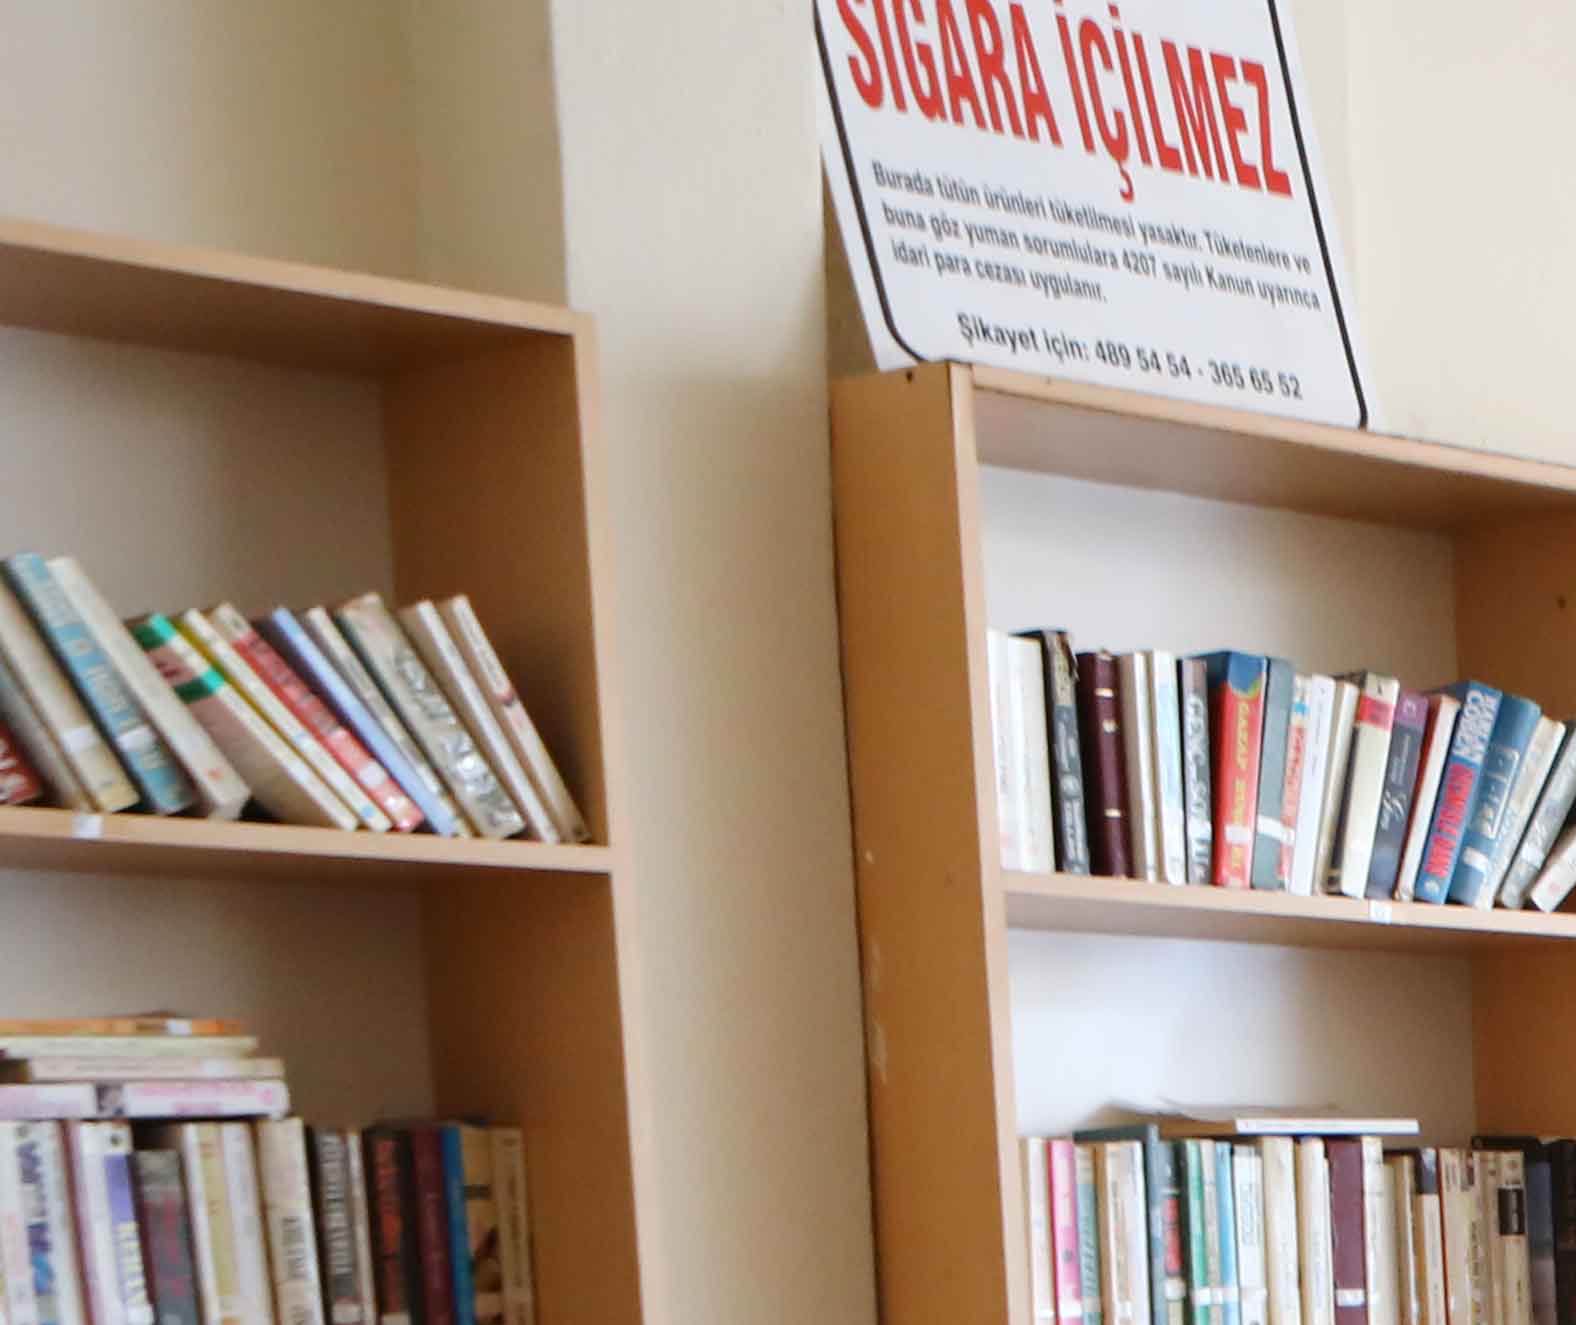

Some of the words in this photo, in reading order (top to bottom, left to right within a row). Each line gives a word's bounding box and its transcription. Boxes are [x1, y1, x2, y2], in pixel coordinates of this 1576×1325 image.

[872, 159, 934, 197] Burada
[936, 175, 980, 205] tütün
[983, 182, 1048, 219] ürünleri
[1049, 197, 1136, 239] tüketilmesi
[1138, 219, 1202, 250] yasaktır.
[1292, 254, 1312, 275] ve
[881, 201, 926, 231] buna
[930, 211, 961, 242] göz
[963, 221, 1020, 249] yuman
[1022, 232, 1119, 270] sorumlulara
[1121, 249, 1157, 278] 4207
[1162, 259, 1205, 292] sayılı
[1205, 264, 1255, 297] Kanun
[1257, 279, 1322, 312] uyarınca
[933, 249, 973, 279] para
[974, 257, 1027, 286] cezası
[1029, 270, 1108, 304] uygulanır.
[957, 311, 1039, 354] Şikayet
[1044, 331, 1090, 364] için:
[1095, 340, 1132, 370] 489
[1136, 347, 1162, 375] 54
[1167, 354, 1193, 379] 54
[1208, 359, 1246, 391] 365
[1249, 369, 1275, 395] 65
[1278, 374, 1304, 401] 52
